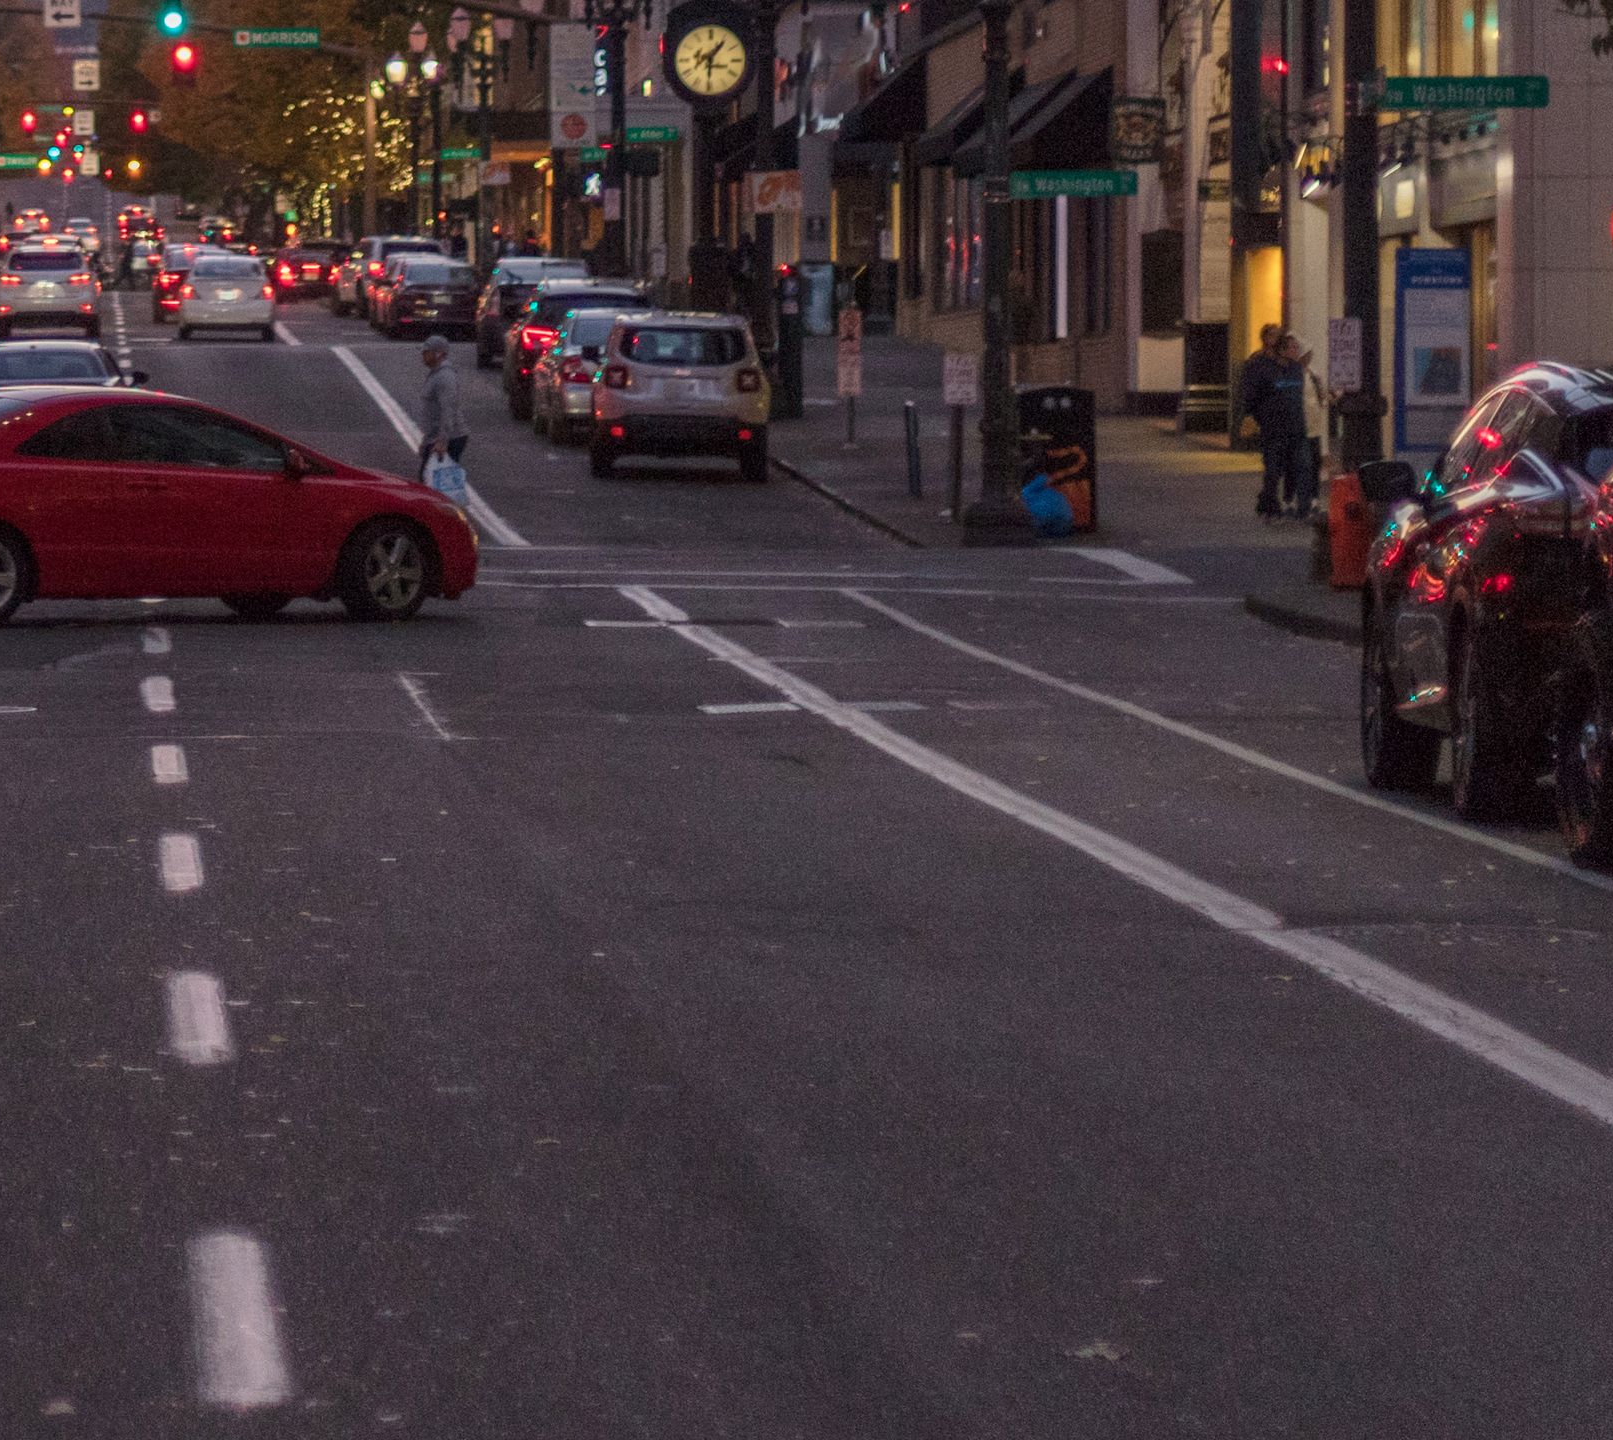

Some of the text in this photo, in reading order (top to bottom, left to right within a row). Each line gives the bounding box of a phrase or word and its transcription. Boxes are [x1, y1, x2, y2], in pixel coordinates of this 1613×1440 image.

[49, 0, 74, 8] WAY
[252, 31, 318, 45] MORRISON
[1413, 84, 1515, 106] Washington
[1035, 178, 1114, 196] Washington
